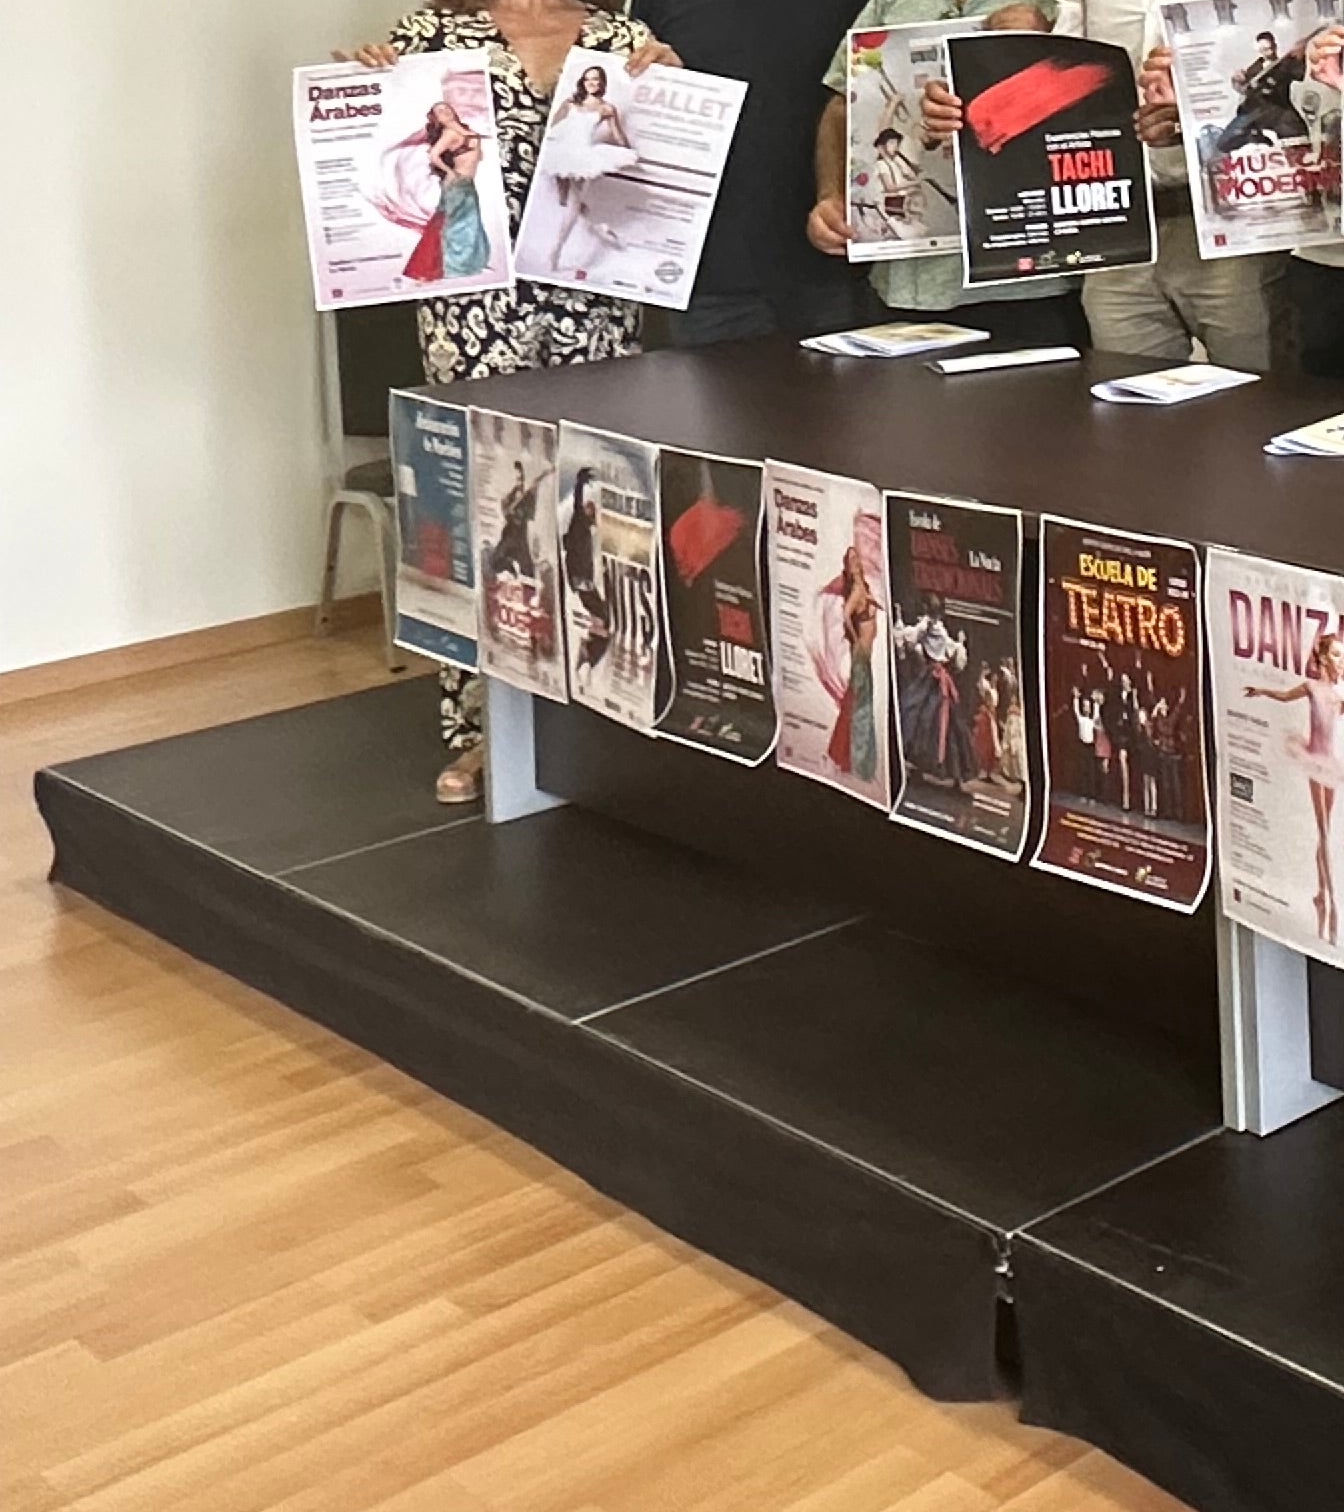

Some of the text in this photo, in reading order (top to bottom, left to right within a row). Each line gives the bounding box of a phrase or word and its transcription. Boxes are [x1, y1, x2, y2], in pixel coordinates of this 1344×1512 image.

[307, 81, 382, 102] Danzas
[632, 82, 734, 118] BALLET
[309, 102, 383, 123] Árabes
[1048, 148, 1114, 182] TACHI
[1050, 178, 1132, 216] LLORET
[774, 487, 818, 519] Danzas
[1079, 553, 1158, 591] ESCUELA DE
[1061, 576, 1186, 658] TEATRO
